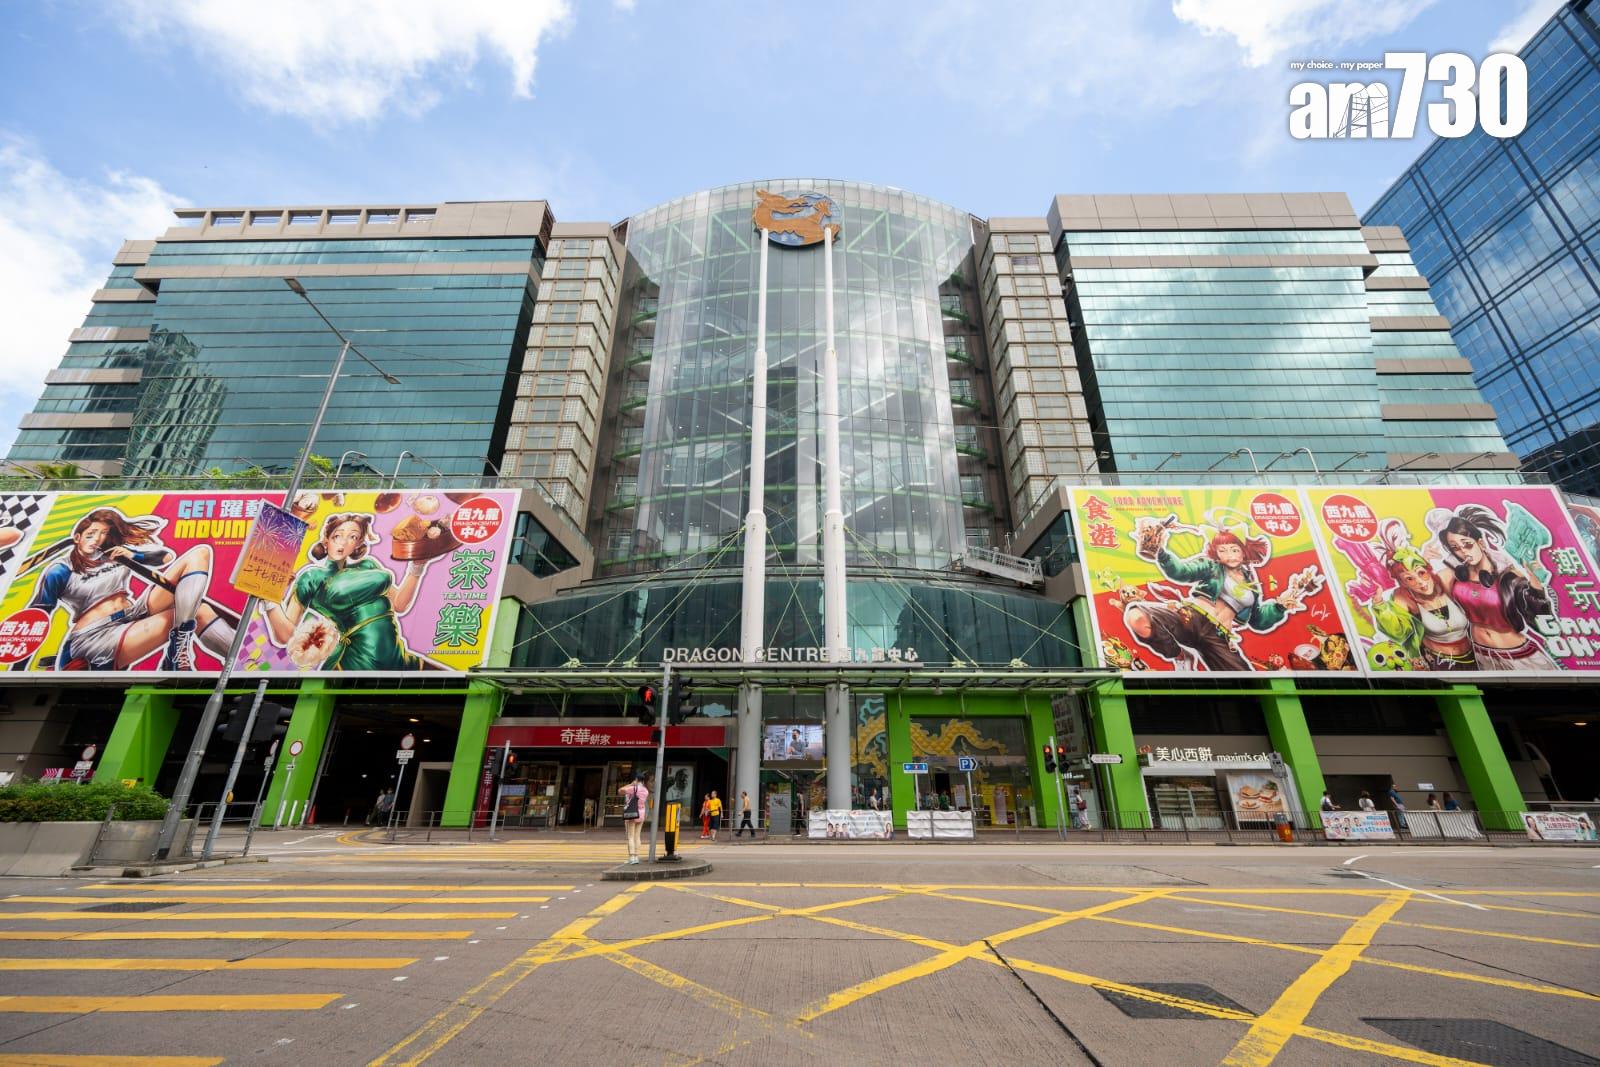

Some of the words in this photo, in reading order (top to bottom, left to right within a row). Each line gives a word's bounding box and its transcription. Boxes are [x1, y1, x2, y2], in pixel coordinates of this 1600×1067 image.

[177, 499, 216, 519] GET
[457, 508, 500, 521] 西九龍
[1252, 502, 1295, 515] 西九龍
[1324, 505, 1371, 518] 西九龍
[460, 526, 488, 539] 中心
[1265, 520, 1294, 532] 中心
[1339, 524, 1370, 537] 中心
[448, 549, 494, 590] 茶
[443, 592, 461, 600] TEA
[463, 592, 488, 600] TIME
[0, 621, 48, 635] 西九龍
[663, 647, 743, 662] DRAGON
[1155, 746, 1213, 762] 美心西餅
[1217, 752, 1252, 762] maxim's
[961, 759, 969, 769] P
